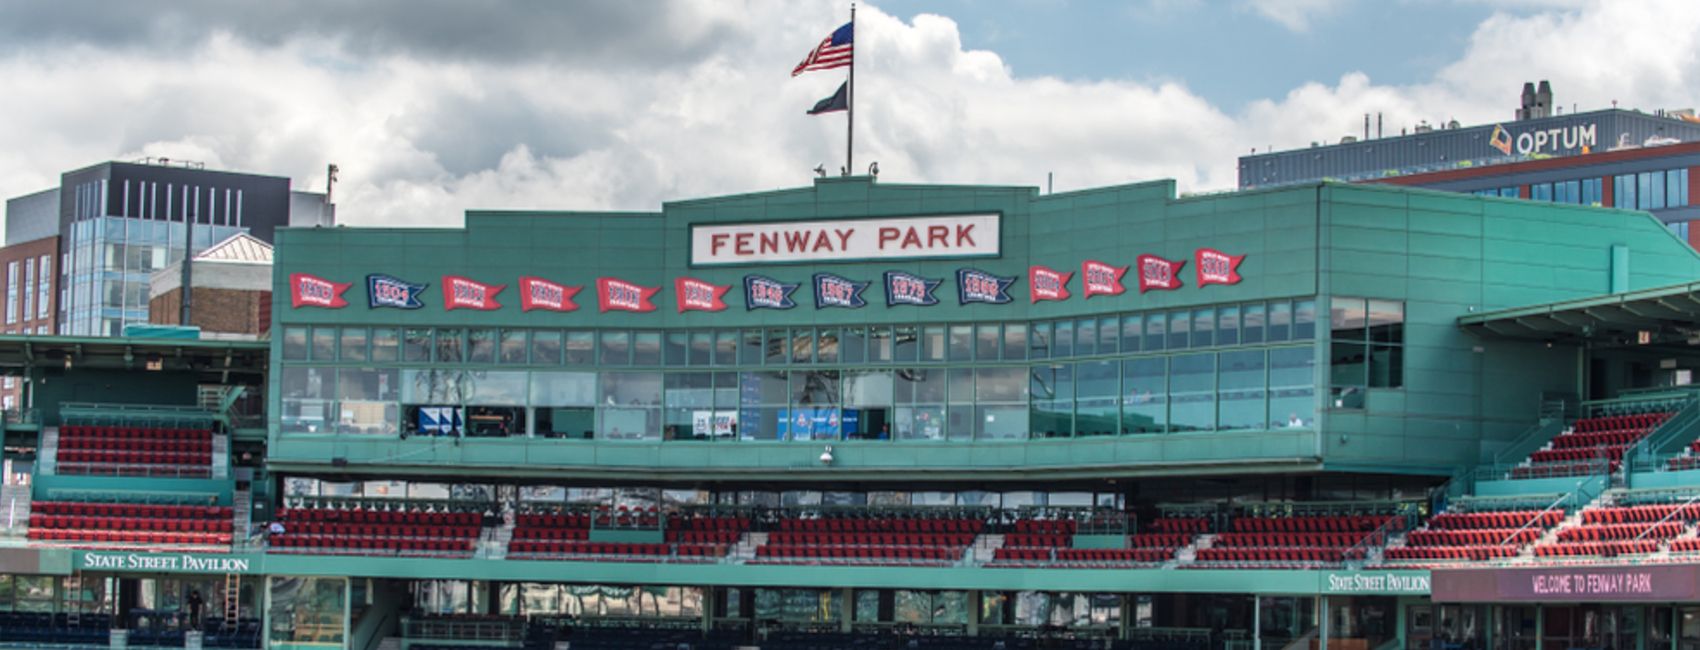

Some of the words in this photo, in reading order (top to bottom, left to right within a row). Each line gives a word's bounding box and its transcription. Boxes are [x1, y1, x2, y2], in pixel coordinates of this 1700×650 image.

[1516, 123, 1597, 154] OPTUM
[710, 229, 855, 256] FENWAY
[878, 224, 976, 249] PARK
[84, 552, 126, 567] STATE
[182, 555, 249, 571] PAVILION
[1328, 573, 1353, 591] STATE
[1354, 573, 1385, 591] STREET
[1386, 573, 1431, 591] PAVILION
[1532, 575, 1571, 593] WELCOME
[1574, 575, 1585, 593] TO
[1587, 574, 1624, 592] FENWAY
[1626, 573, 1652, 592] PARK
